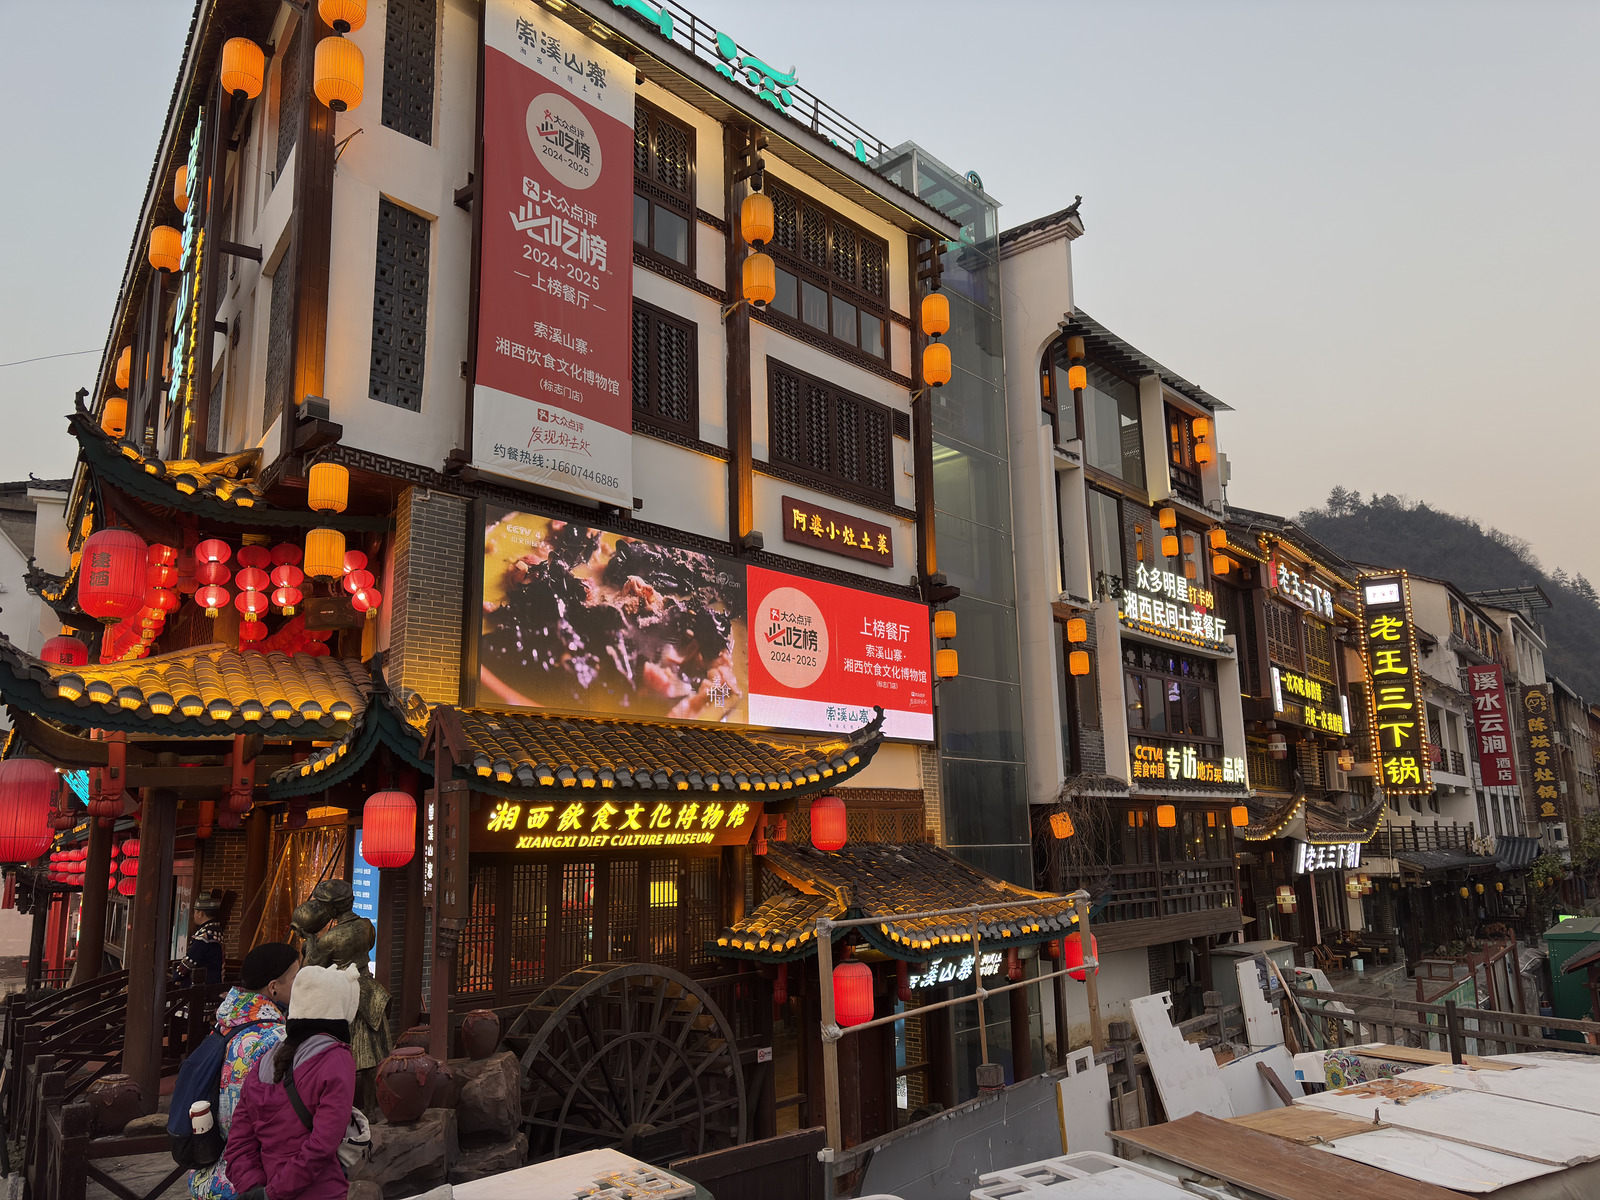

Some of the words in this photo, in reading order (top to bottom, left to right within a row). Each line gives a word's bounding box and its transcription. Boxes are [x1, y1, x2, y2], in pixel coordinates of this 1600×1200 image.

[515, 16, 607, 88] 索溪山寨
[553, 115, 585, 139] 大众点评
[536, 121, 590, 163] 必吃榜
[542, 145, 589, 177] 2024-2025
[541, 189, 598, 229] 大众点评
[508, 200, 608, 272] 必吃榜
[522, 244, 600, 291] 2024-2025
[531, 271, 590, 310] 上榜餐厅
[495, 336, 620, 396] 湘西饮食文化博物馆
[539, 378, 584, 404] (标志门店)
[550, 412, 584, 433] 大众点评
[527, 426, 592, 452] 发现好去处
[506, 524, 532, 536] CCTV
[792, 508, 889, 555] 阿婆小灶土菜
[1136, 562, 1214, 609] 众多明星打卡的
[1277, 562, 1334, 619] 老王三下锅
[781, 611, 812, 627] 大众点评
[859, 616, 910, 643] 上榜餐厅
[1123, 589, 1227, 642] 湘西民间土菜餐厅
[764, 622, 818, 653] 必吃榜
[770, 651, 817, 667] 2024-2025
[843, 658, 927, 683] 湘西饮食文化博物馆
[1369, 614, 1421, 785] 老王三下锅
[1472, 671, 1507, 754] 溪水云涧
[826, 706, 869, 724] 索溪山寨
[1135, 745, 1163, 762] CCTV4
[1133, 761, 1165, 779] 美食中国
[1496, 757, 1512, 781] 酒店
[516, 835, 577, 849] XIANGXI
[577, 834, 611, 848] DIET
[610, 833, 664, 847] CULTURE
[664, 831, 715, 846] MUSEUM
[1305, 844, 1355, 871] 老王三下锅
